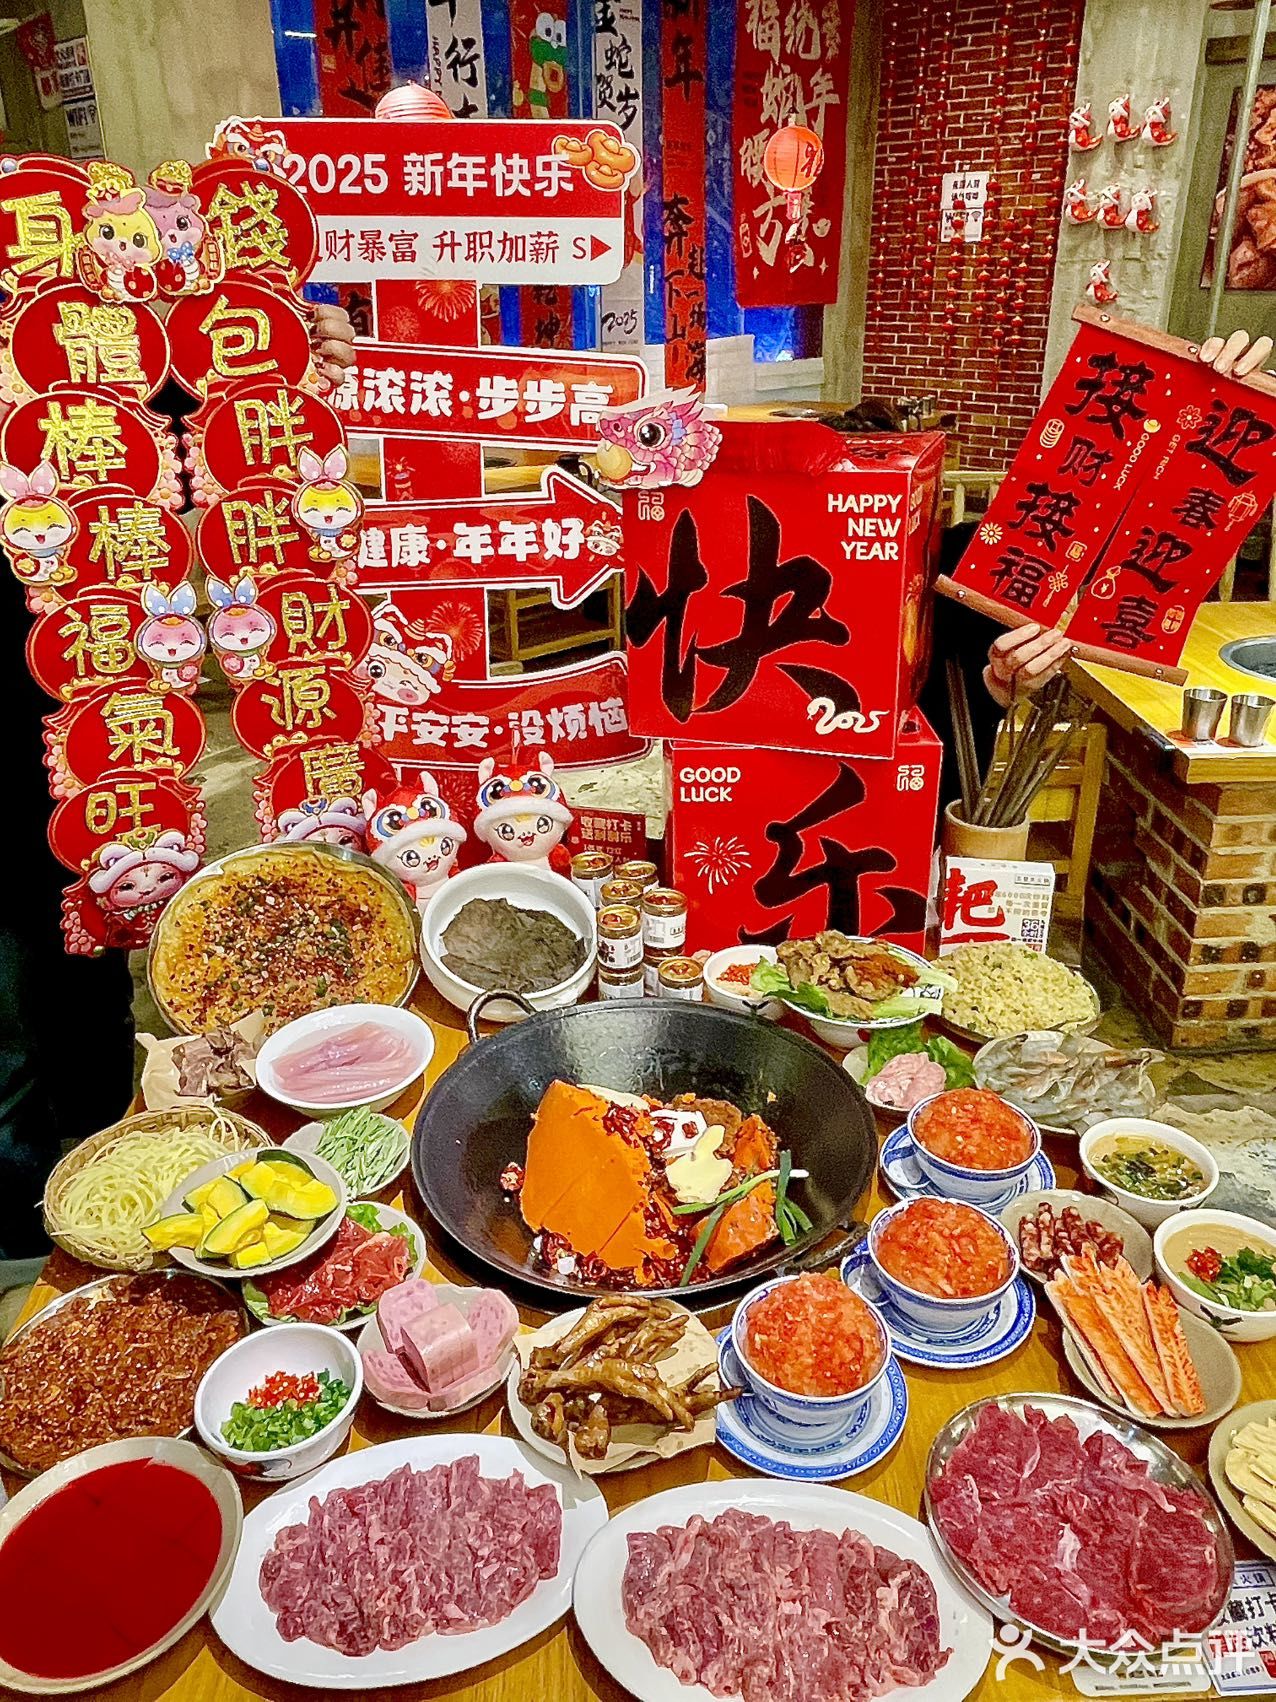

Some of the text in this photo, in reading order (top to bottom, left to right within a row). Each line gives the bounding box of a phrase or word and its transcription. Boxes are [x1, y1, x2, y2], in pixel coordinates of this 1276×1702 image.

[282, 153, 574, 197] 2025 新年快乐
[317, 229, 417, 264] 财暴富
[432, 229, 560, 265] 升职加薪
[601, 309, 638, 335] 2025
[1113, 433, 1149, 491] GOOD LUCK
[1166, 434, 1180, 454] GET
[988, 352, 1155, 608] 接财接福
[827, 493, 903, 514] HAPPY
[847, 517, 901, 537] NEW
[1101, 399, 1275, 649] 迎春迎喜
[840, 541, 899, 561] YEAR
[626, 494, 862, 725] 快
[806, 696, 889, 734] 2025
[679, 766, 741, 784] GOOD
[680, 786, 733, 803] LUCK
[738, 761, 926, 943] 乐
